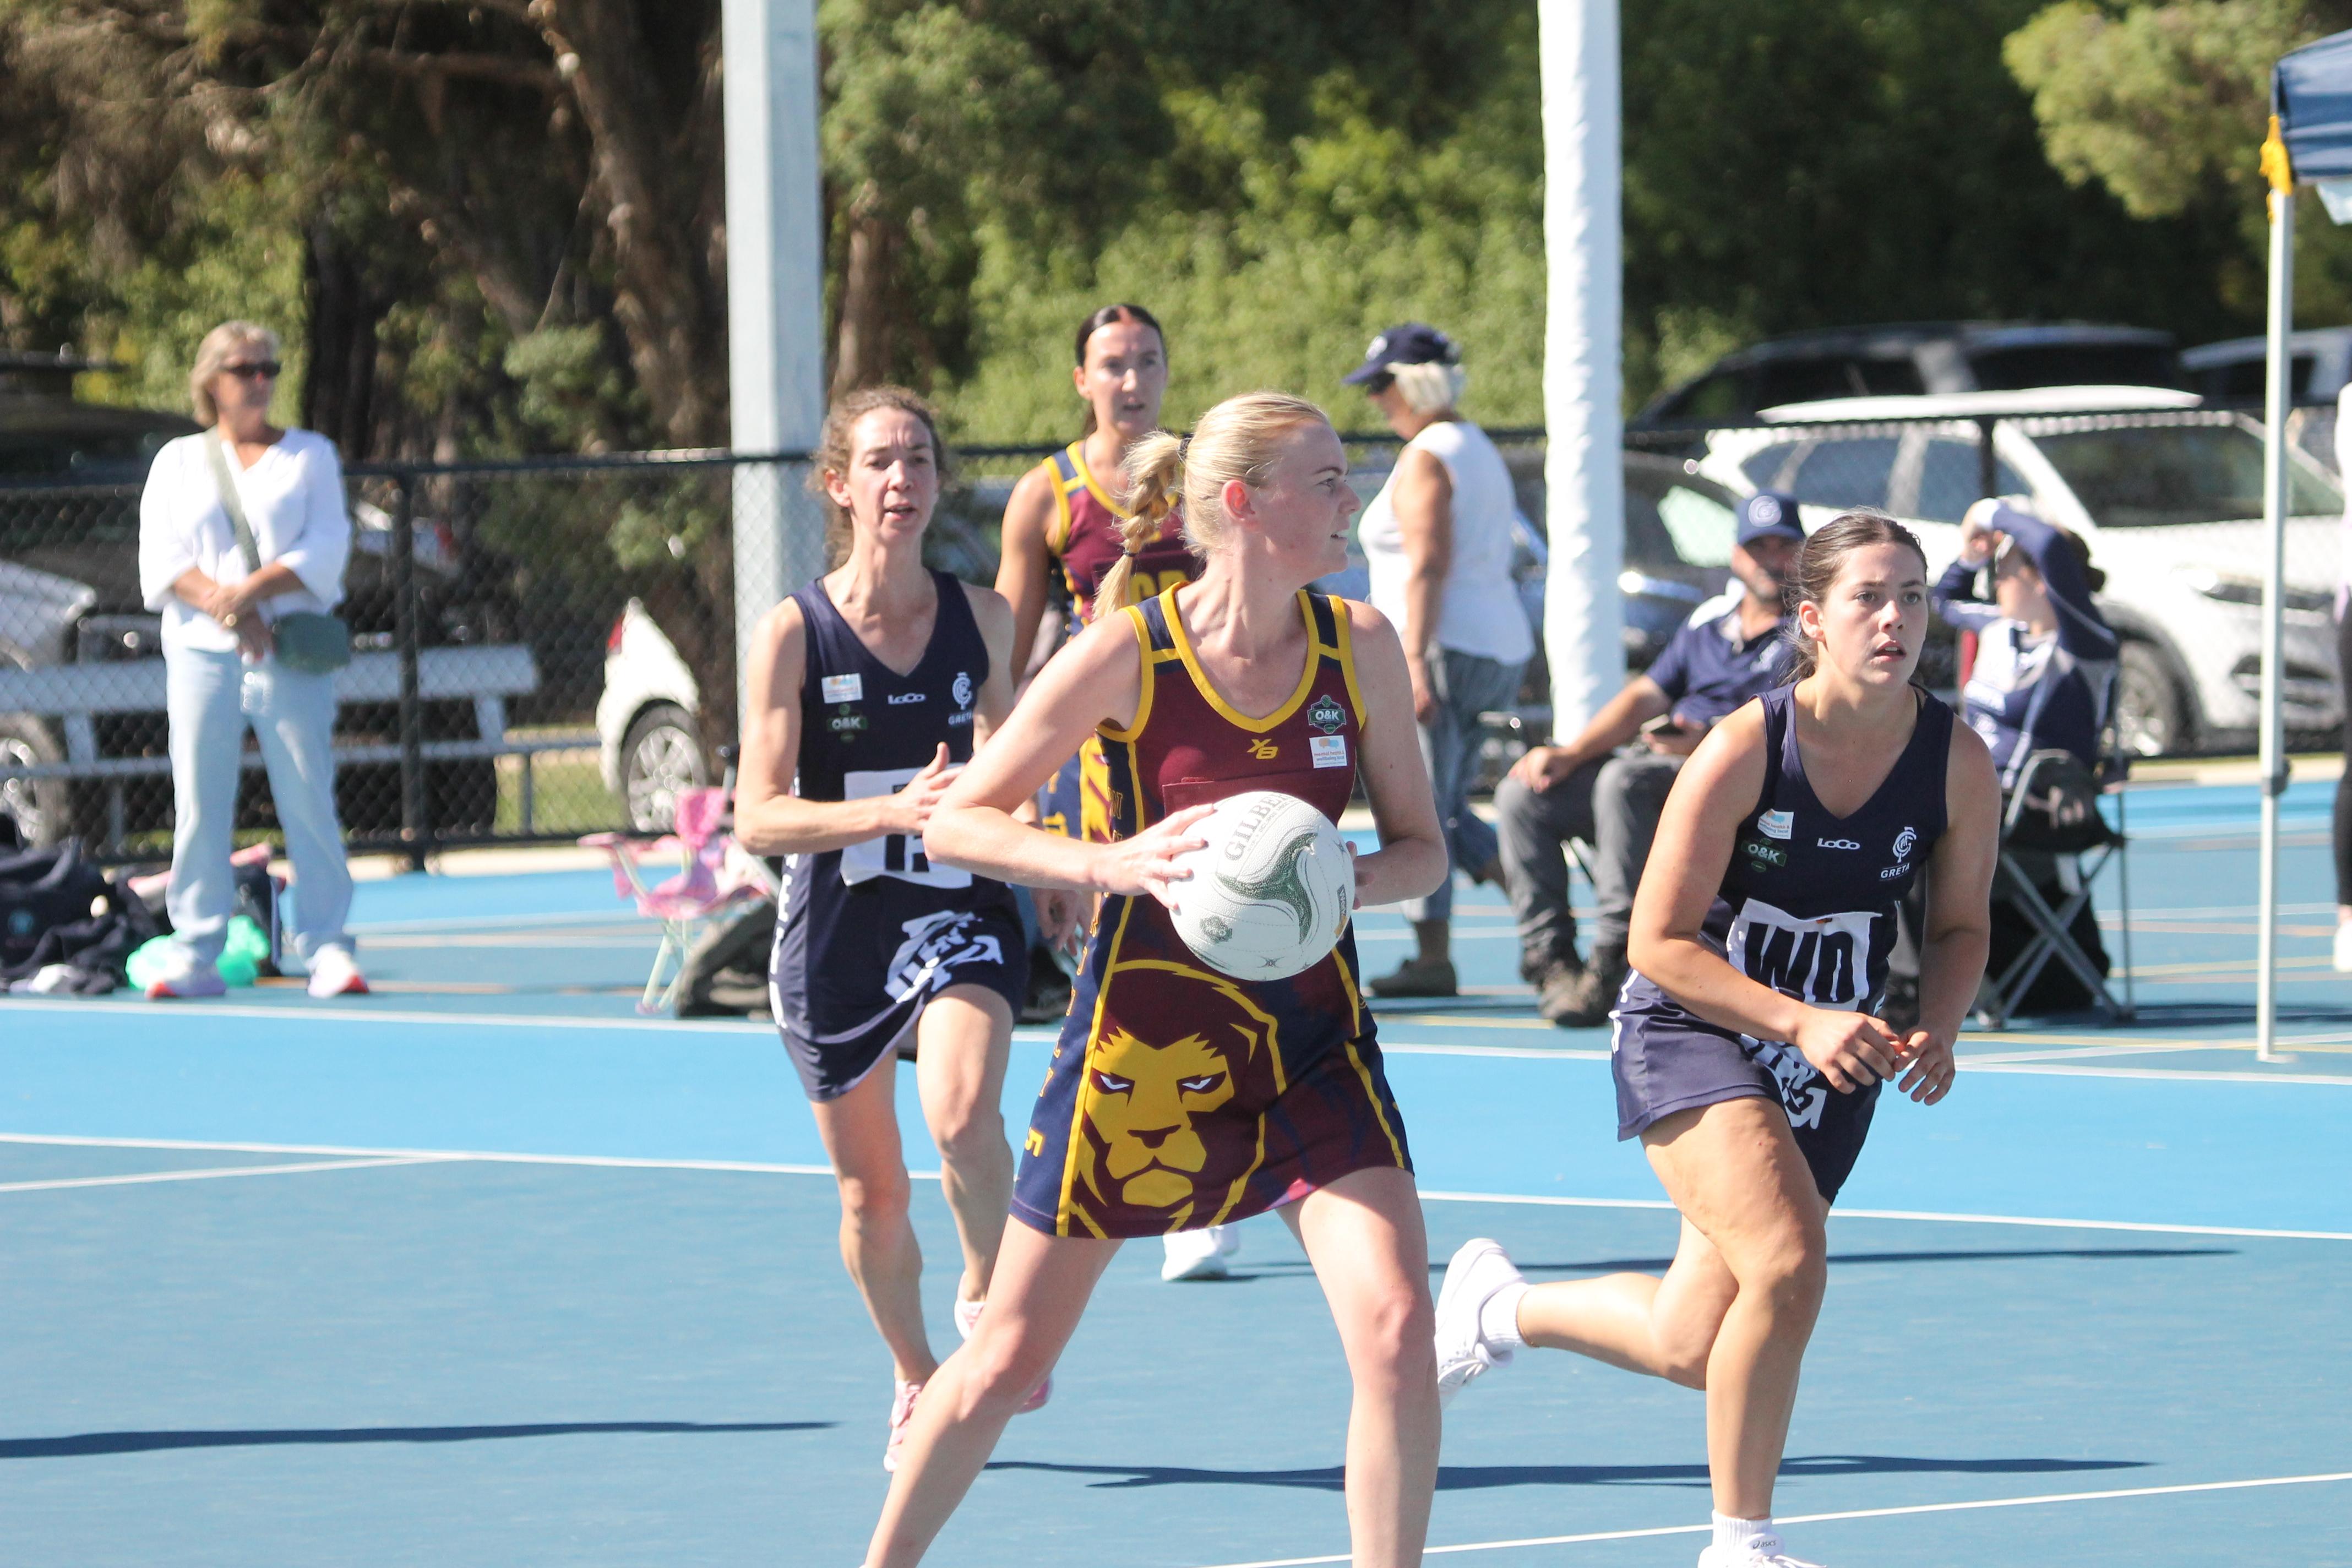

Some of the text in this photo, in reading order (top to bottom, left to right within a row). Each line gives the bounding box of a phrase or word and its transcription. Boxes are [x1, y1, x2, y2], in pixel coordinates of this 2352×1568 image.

[1315, 710, 1340, 721] O&K
[1817, 837, 1861, 850] LoCo
[1747, 843, 1780, 864] O&K
[1881, 863, 1910, 879] GRETA
[1744, 922, 1855, 1004] WD
